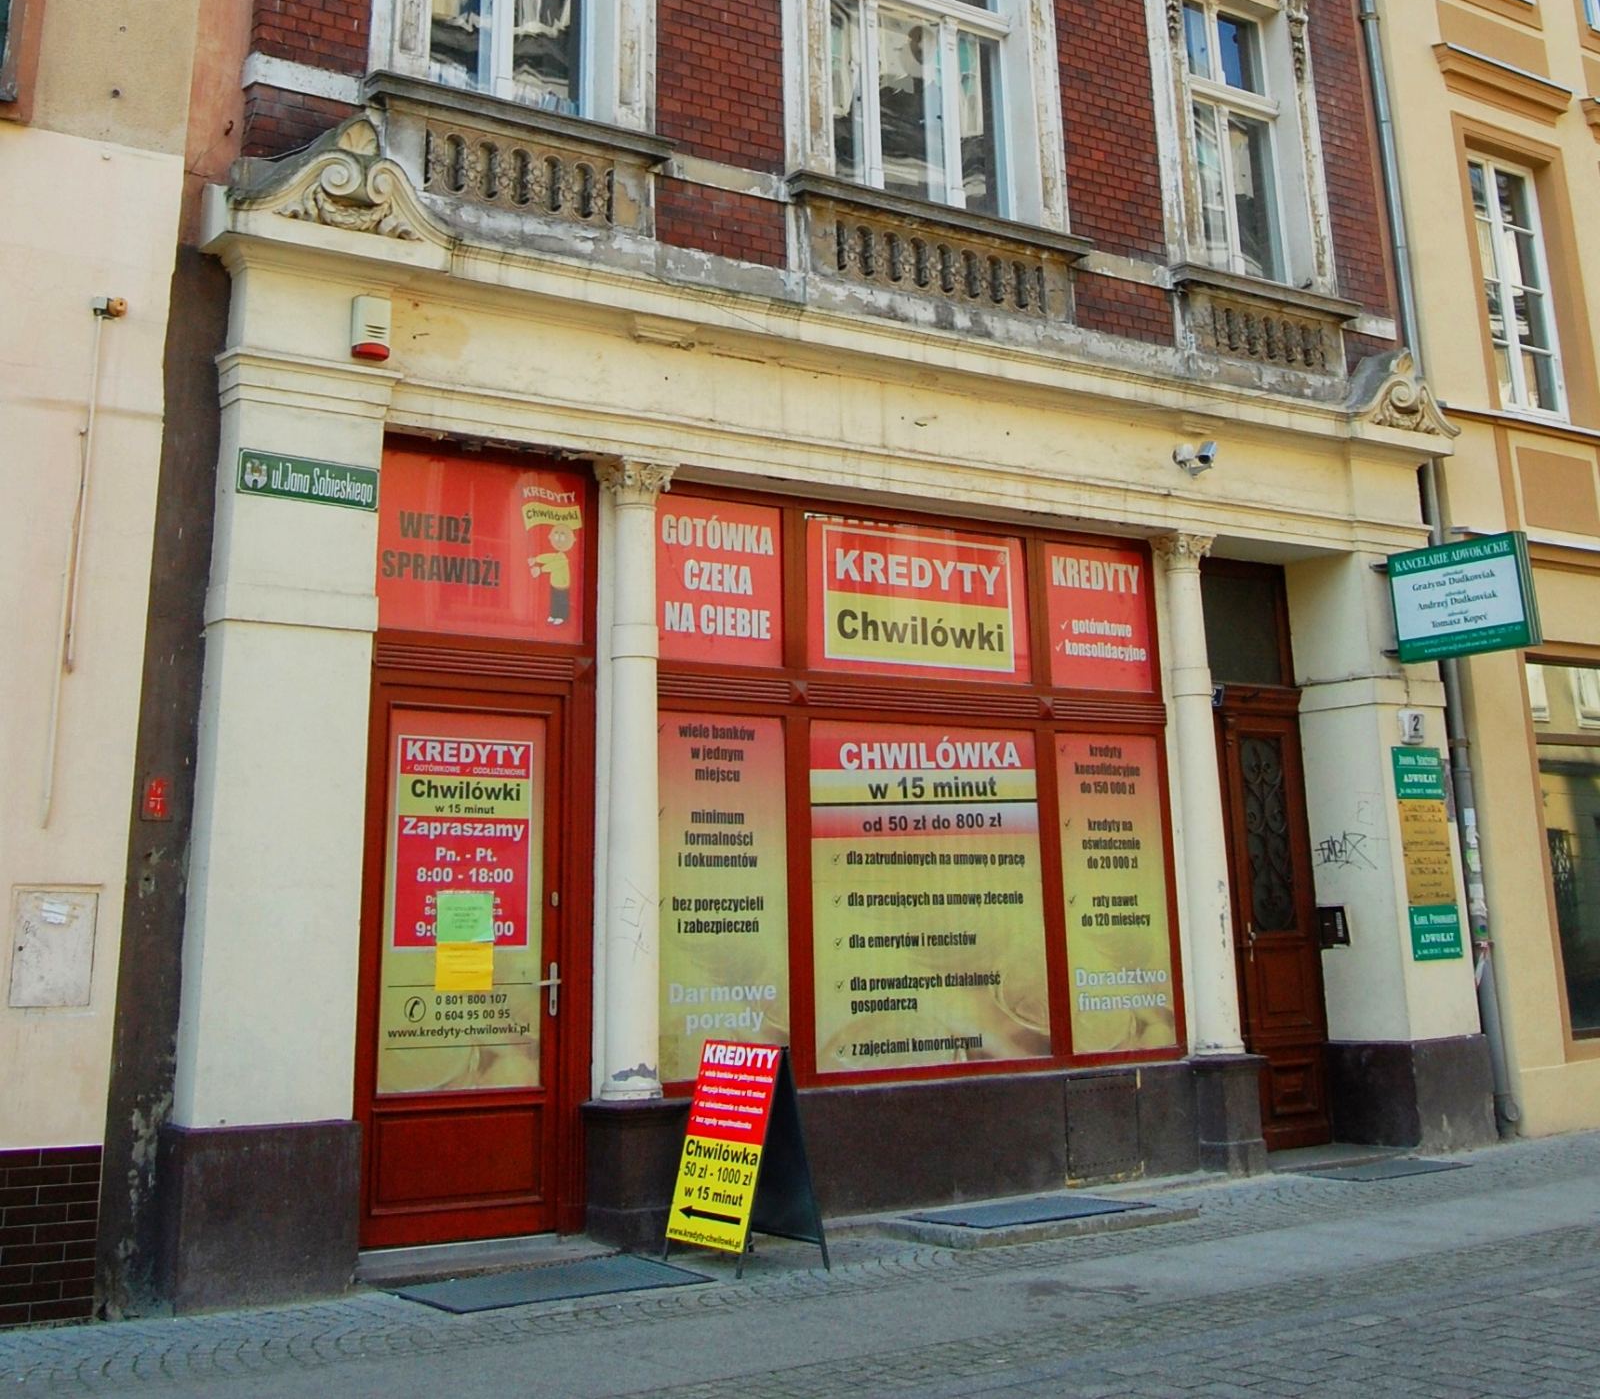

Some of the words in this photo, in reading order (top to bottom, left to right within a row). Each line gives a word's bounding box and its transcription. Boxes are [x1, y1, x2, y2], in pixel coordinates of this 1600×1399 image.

[312, 467, 373, 505] Sobieskiego
[523, 486, 576, 503] KREDYTY
[400, 511, 472, 544] WEJDŹ
[662, 514, 774, 556] GOTÓWKA
[1394, 553, 1449, 573] KANCELARIE
[1451, 540, 1510, 562] ADWOKACKIE
[382, 550, 500, 587] SPRAWDŹ!
[684, 559, 753, 595] CZEKA
[835, 548, 1000, 596] KREDYTY
[1051, 555, 1139, 595] KREDYTY
[1417, 598, 1449, 611] Andrzej
[665, 601, 696, 633] NA
[700, 604, 771, 640] CIEBIE
[1072, 618, 1132, 638] gotówkowe
[1431, 616, 1461, 629] Tomasz
[837, 609, 1004, 652] Chwilówki
[1065, 639, 1147, 661] konsolidacyjne
[679, 723, 710, 739] wiele
[712, 725, 755, 741] banków
[1412, 715, 1420, 732] 2
[406, 740, 525, 765] KREDYTY
[691, 747, 700, 759] w
[702, 745, 744, 762] jednym
[839, 736, 1022, 770] CHWILÓWKA
[1089, 744, 1122, 759] kredyty
[695, 767, 740, 783] miejscu
[1074, 762, 1141, 777] konsolidacyjne
[411, 779, 520, 801] Chwilówki
[868, 783, 888, 799] w
[897, 776, 925, 799] 15
[932, 776, 997, 798] minut
[1080, 782, 1091, 793] do
[1093, 782, 1108, 794] 150
[1110, 782, 1126, 794] 000
[1128, 783, 1135, 795] zł
[435, 805, 445, 813] w
[448, 804, 461, 813] 15
[464, 804, 495, 814] minut
[691, 809, 744, 825] minimum
[402, 817, 525, 842] Zapraszamy
[863, 817, 882, 832] od
[888, 816, 908, 831] 50
[913, 815, 926, 830] zł
[932, 814, 950, 830] do
[956, 813, 984, 829] 800
[989, 812, 1002, 827] zł
[1088, 818, 1120, 832] kredyty
[1122, 820, 1133, 831] na
[685, 830, 753, 846] formalności
[1082, 837, 1141, 850] oświadczenie
[436, 847, 460, 861] Pn.
[476, 848, 497, 862] Pt.
[684, 852, 758, 868] dokumentów
[846, 851, 863, 865] dla
[865, 850, 937, 867] zatrudnionych
[939, 853, 951, 865] na
[953, 853, 989, 867] umowę
[990, 853, 996, 865] o
[998, 853, 1025, 868] pracę
[1087, 856, 1098, 869] do
[1100, 856, 1111, 869] 20
[1113, 856, 1129, 869] 000
[1131, 856, 1138, 869] zł
[416, 867, 453, 882] 8:00
[469, 868, 513, 882] 18:00
[672, 897, 691, 911] bez
[694, 896, 763, 914] poręczycieli
[848, 892, 865, 907] dla
[866, 892, 930, 909] pracujących
[932, 893, 945, 906] na
[946, 893, 982, 908] umowę
[983, 891, 1024, 905] zlecenie
[1092, 895, 1110, 908] raty
[1111, 894, 1138, 907] nawet
[684, 917, 759, 934] zabezpieczeń
[1081, 913, 1092, 927] do
[1094, 913, 1109, 927] 120
[1111, 913, 1151, 927] miesięcy
[849, 934, 866, 949] dla
[867, 933, 919, 949] emerytów
[927, 931, 977, 947] rencistów
[850, 976, 866, 991] dla
[869, 974, 942, 992] prowadzących
[944, 971, 1001, 988] działalność
[1075, 967, 1167, 987] Doradztwo
[435, 995, 442, 1005] 0
[445, 995, 463, 1005] 801
[468, 995, 486, 1004] 800
[490, 994, 508, 1004] 107
[669, 983, 777, 1004] Darmowe
[1078, 992, 1167, 1011] finansowe
[435, 1011, 441, 1020] 0
[445, 1011, 464, 1020] 604
[467, 1010, 479, 1020] 95
[483, 1009, 495, 1019] 00
[498, 1009, 510, 1019] 95
[851, 997, 918, 1014] gospodarczą
[686, 1008, 764, 1035] porady
[388, 1024, 530, 1038] www.kredyty-chwilowki.pl
[852, 1043, 856, 1056] z
[859, 1038, 909, 1057] zajęciami
[911, 1033, 983, 1053] komorniczymi
[703, 1043, 779, 1069] KREDYTY
[686, 1139, 759, 1166] Chwilówka
[684, 1161, 696, 1176] 50
[698, 1164, 708, 1179] zł
[718, 1167, 740, 1184] 1000
[742, 1172, 753, 1186] zł
[684, 1186, 694, 1198] w
[697, 1186, 710, 1201] 15
[712, 1190, 743, 1207] minut
